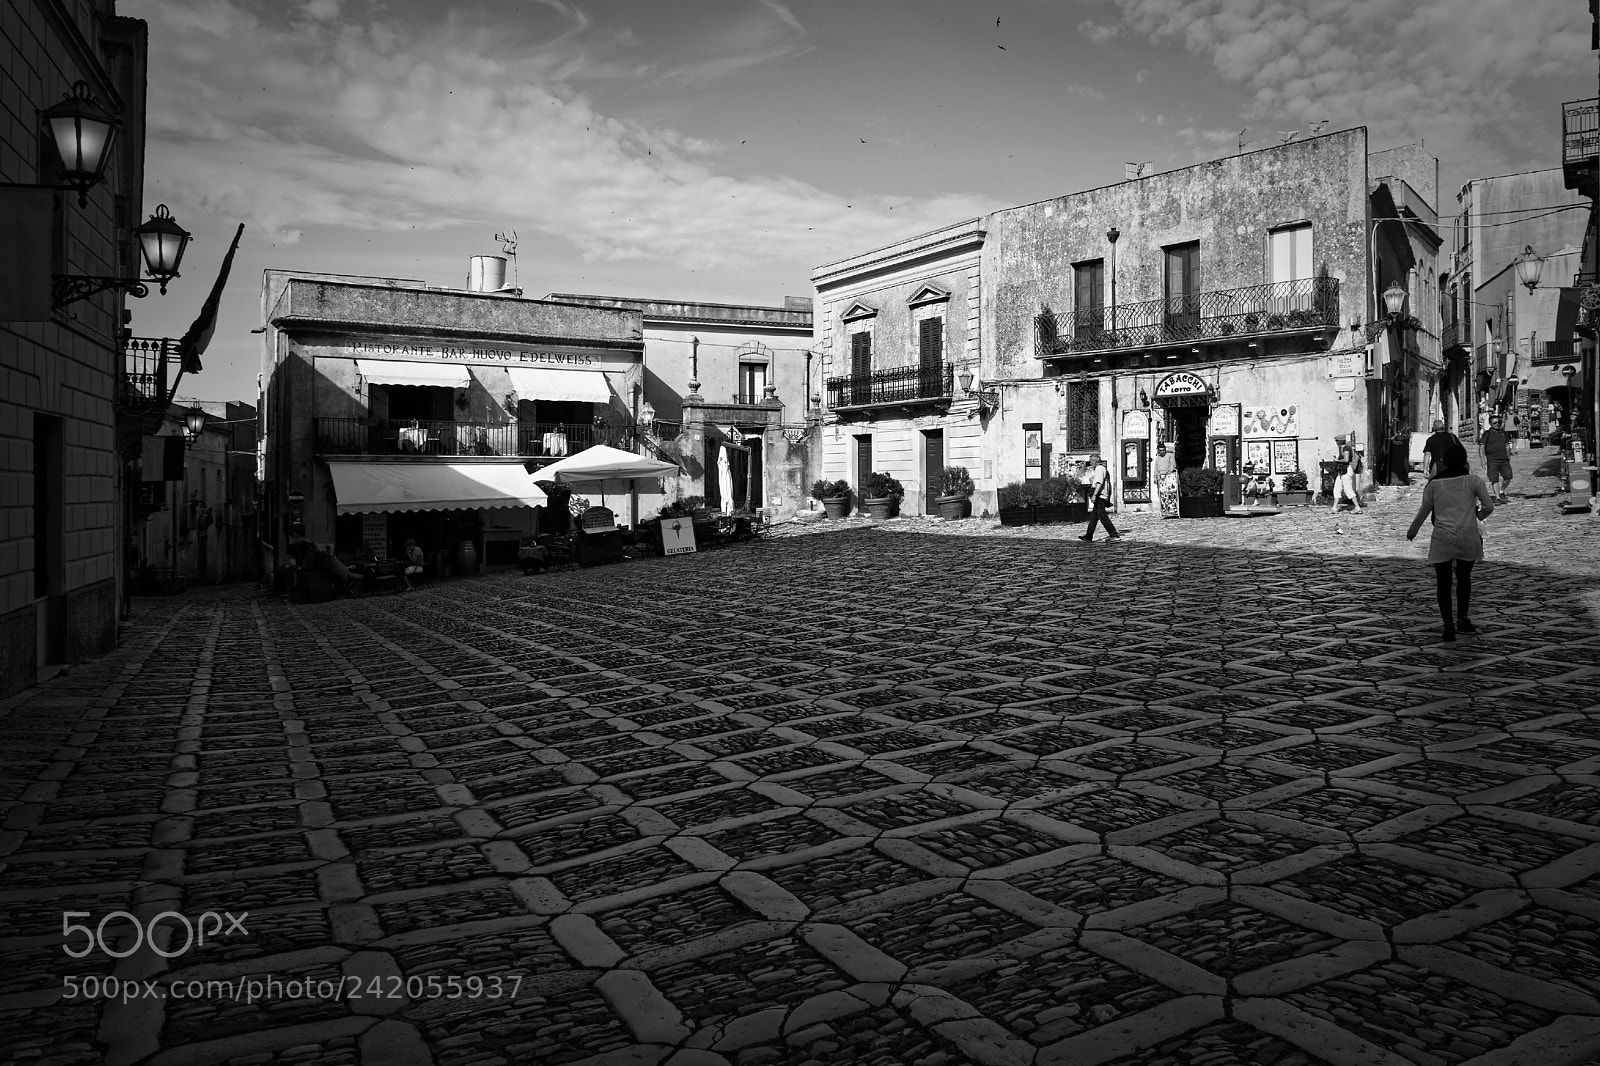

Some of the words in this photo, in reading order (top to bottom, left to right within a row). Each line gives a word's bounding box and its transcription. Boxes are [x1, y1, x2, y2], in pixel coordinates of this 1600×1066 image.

[353, 341, 434, 356] RISTORANTE
[441, 347, 466, 359] BAR
[473, 349, 512, 361] NUOVO
[520, 351, 592, 365] EDELWEISS
[1159, 374, 1202, 393] TABACCHI
[666, 546, 694, 554] GELATERIA
